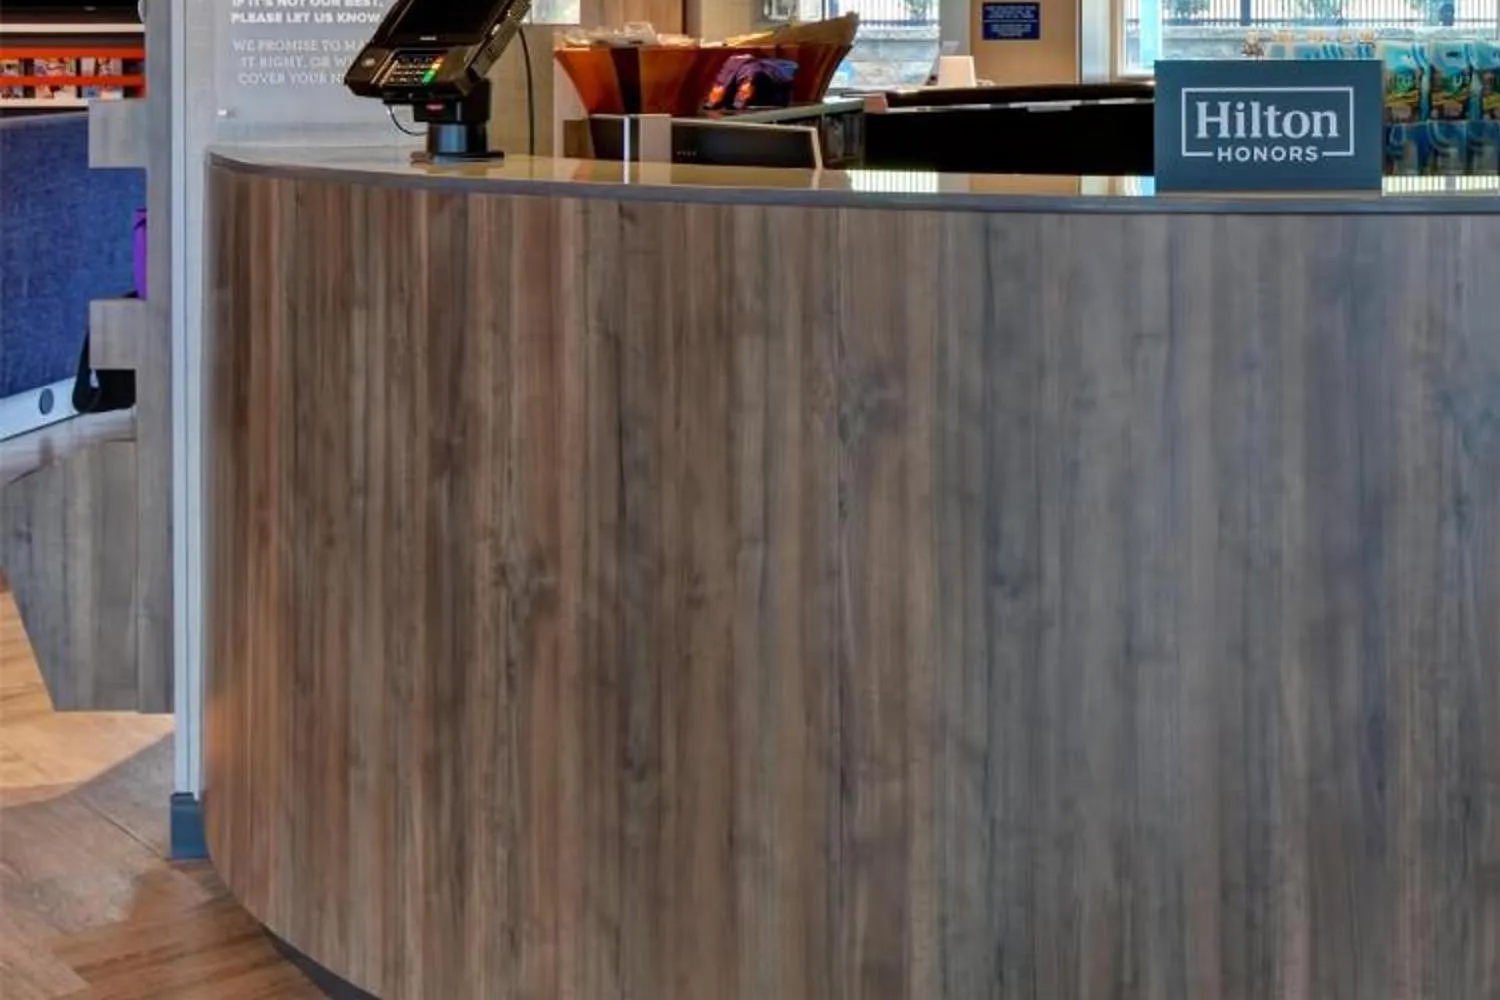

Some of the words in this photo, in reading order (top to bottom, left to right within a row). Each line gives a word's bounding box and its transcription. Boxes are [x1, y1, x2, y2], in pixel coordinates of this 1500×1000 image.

[230, 12, 282, 24] PLEASE
[286, 12, 310, 24] LET
[314, 12, 334, 24] US
[232, 40, 256, 52] WE
[257, 40, 318, 52] PROMISE
[321, 40, 341, 52] TO
[1196, 101, 1339, 139] Hilton
[1217, 145, 1318, 162] HONORS
